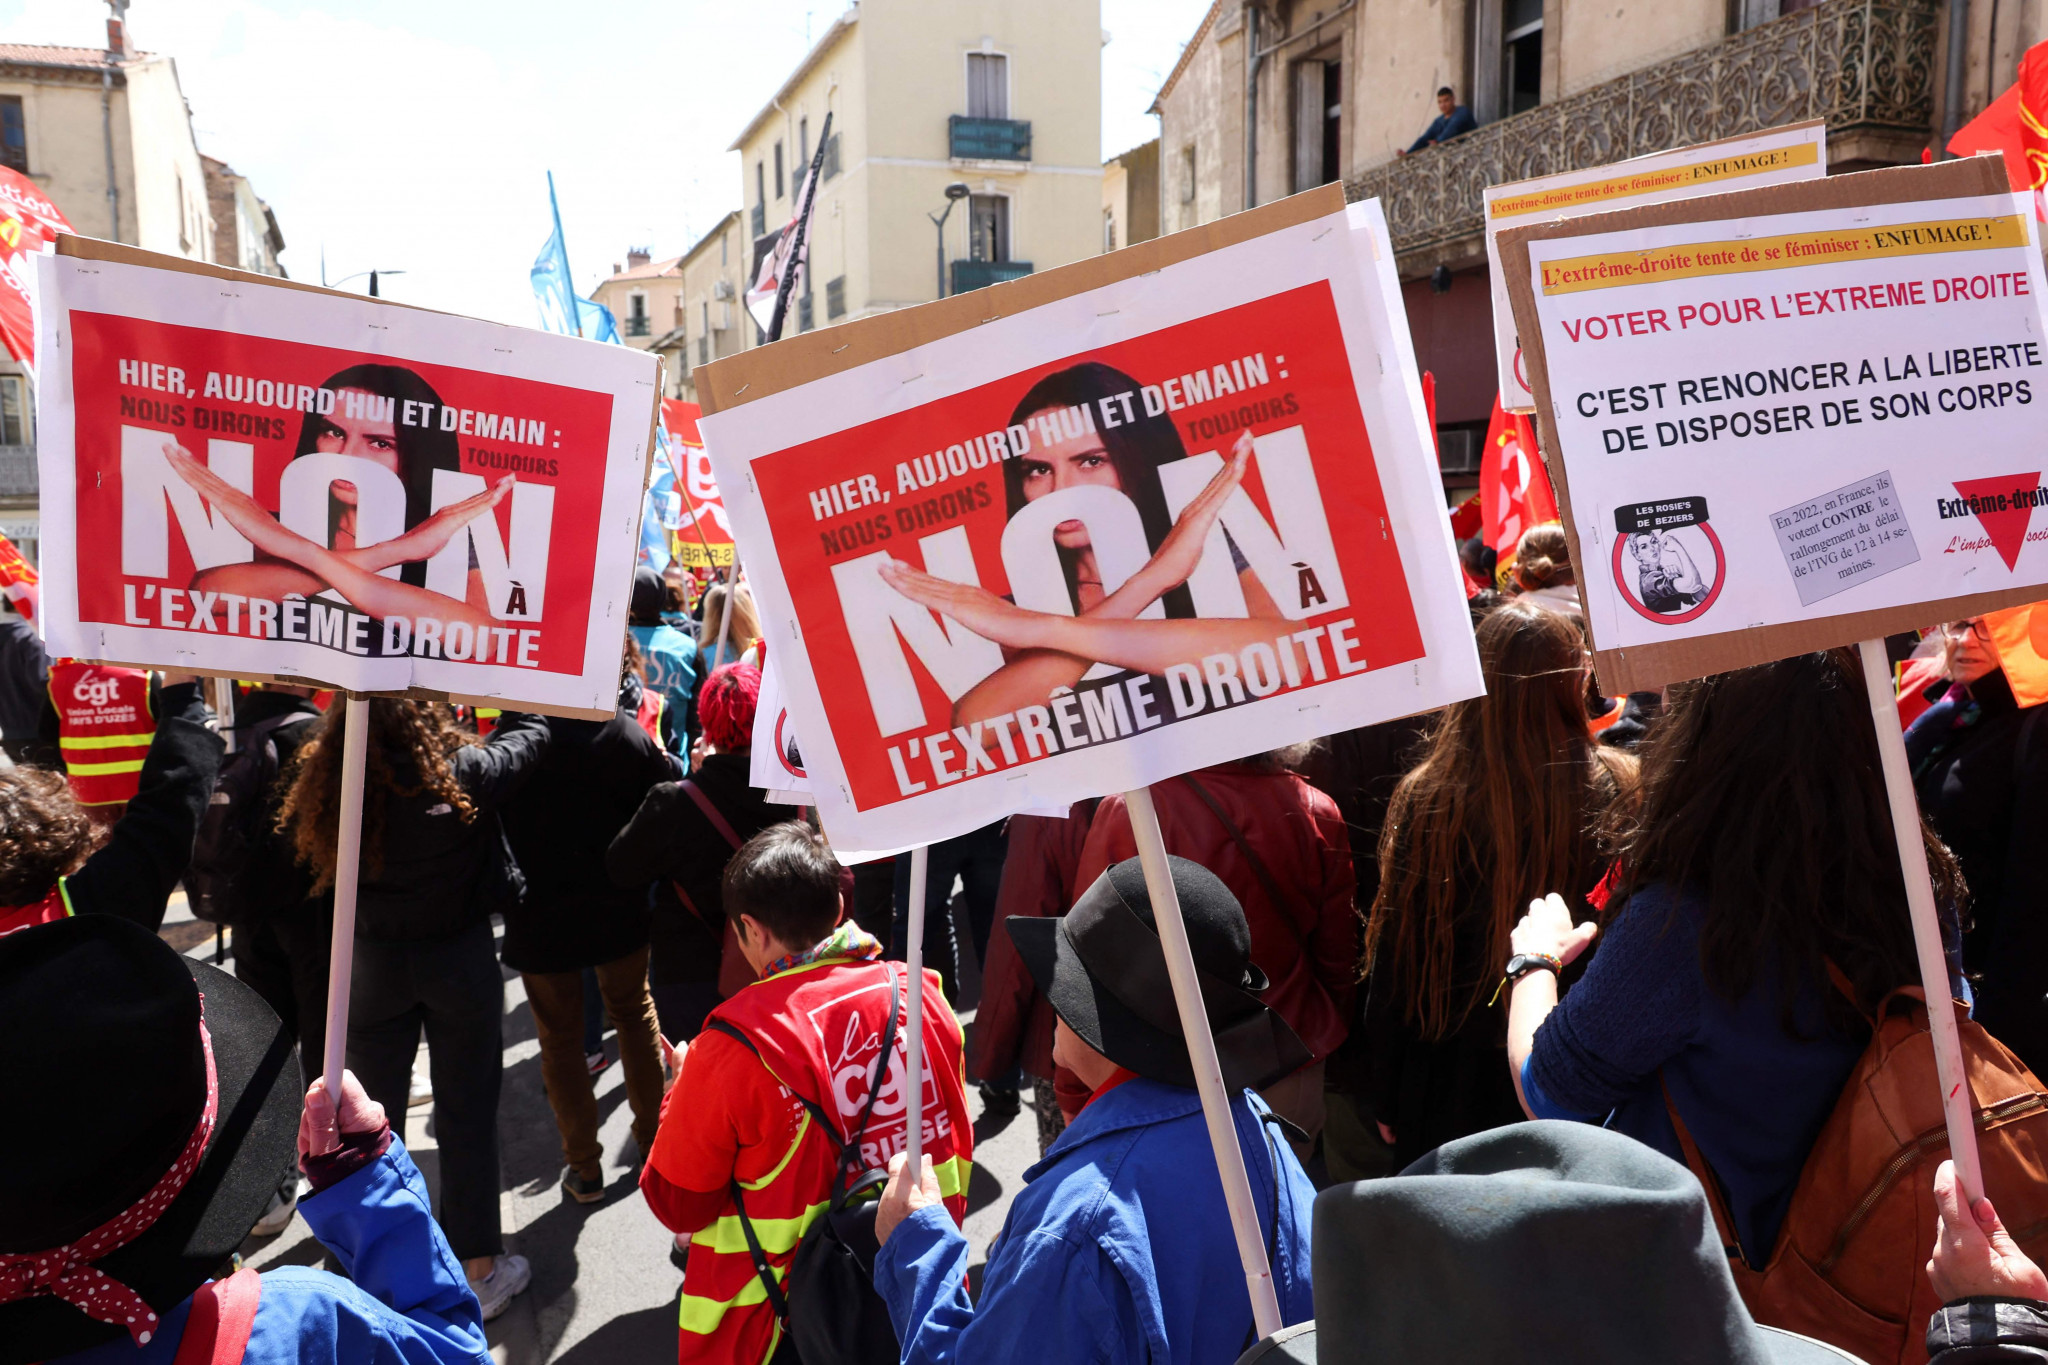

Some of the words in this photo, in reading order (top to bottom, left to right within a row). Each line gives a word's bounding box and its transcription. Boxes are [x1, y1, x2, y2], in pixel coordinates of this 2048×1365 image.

[1491, 191, 1573, 214] L'extrême-droite
[1575, 187, 1600, 203] tente
[1603, 183, 1615, 195] de
[1618, 184, 1628, 192] se
[1631, 172, 1682, 191] féminiser
[1685, 172, 1690, 180] :
[1693, 152, 1780, 179] ENFUMAGE
[1783, 151, 1788, 163] !
[1543, 253, 1692, 286] L'extrême-droite
[1696, 251, 1736, 266] tente
[1740, 243, 1760, 262] de
[1764, 247, 1781, 260] se
[1786, 237, 1860, 258] féminiser
[1865, 238, 1872, 250] :
[1874, 224, 1982, 249] ENFUMAGE
[1985, 223, 1993, 239] !
[1561, 309, 1671, 343] VOTER
[1678, 297, 1765, 329] POUR
[1771, 281, 1926, 319] L'EXTREME
[1932, 272, 2030, 303] DROITE
[119, 358, 196, 399] HIER,
[203, 371, 395, 424] AUJOURD'HUI
[402, 399, 434, 428] ET
[440, 405, 546, 446] DEMAIN
[552, 429, 562, 448] :
[1577, 383, 1667, 418] C'EST
[1678, 361, 1850, 406] RENONCER
[1858, 359, 1877, 384] A
[1884, 354, 1922, 381] LA
[1928, 342, 2042, 377] LIBERTE
[120, 395, 187, 428] NOUS
[193, 406, 286, 440] DIRONS
[808, 473, 891, 521] HIER,
[895, 402, 1096, 496] AUJOURD'HUI
[1098, 391, 1135, 429] ET
[1140, 352, 1269, 418] DEMAIN
[1275, 354, 1289, 379] :
[1186, 392, 1300, 443] TOUJOURS
[1602, 425, 1648, 454] DE
[1655, 405, 1814, 447] DISPOSER
[1821, 399, 1862, 427] DE
[1870, 391, 1931, 418] SON
[1938, 380, 2032, 412] CORPS
[467, 447, 559, 477] TOUJOURS
[121, 424, 556, 622] NON
[820, 514, 893, 556] NOUS
[895, 481, 993, 534] DIRONS
[1636, 506, 1654, 515] LES
[1656, 501, 1692, 512] ROSIE'S
[1637, 519, 1650, 528] DE
[1655, 513, 1694, 525] BEZIERS
[1775, 516, 1792, 529] En
[1793, 504, 1823, 523] 2022,
[1824, 500, 1837, 511] en
[1837, 485, 1875, 506] France,
[1876, 477, 1890, 491] ils
[1788, 523, 1821, 542] votent
[1822, 500, 1875, 529] CONTRE
[1879, 496, 1890, 507] le
[1790, 529, 1856, 561] rallongement
[1858, 522, 1871, 535] du
[1875, 509, 1900, 528] délai
[1794, 566, 1807, 578] de
[1807, 552, 1838, 573] l'IVG
[1840, 547, 1853, 559] de
[1855, 540, 1868, 554] 12
[1870, 537, 1876, 548] à
[1878, 531, 1891, 544] 14
[1893, 527, 1908, 539] se-
[1943, 535, 1995, 554] L'impo
[829, 424, 1350, 738] NON
[1291, 561, 1327, 609] À
[1837, 558, 1875, 579] maines.
[506, 581, 527, 615] À
[124, 583, 370, 654] L'EXTRÊME
[382, 615, 541, 668] DROITE
[73, 677, 120, 706] cgt
[887, 674, 1162, 797] L'EXTRÊME
[1164, 618, 1367, 720] DROITE
[832, 1011, 884, 1071] la
